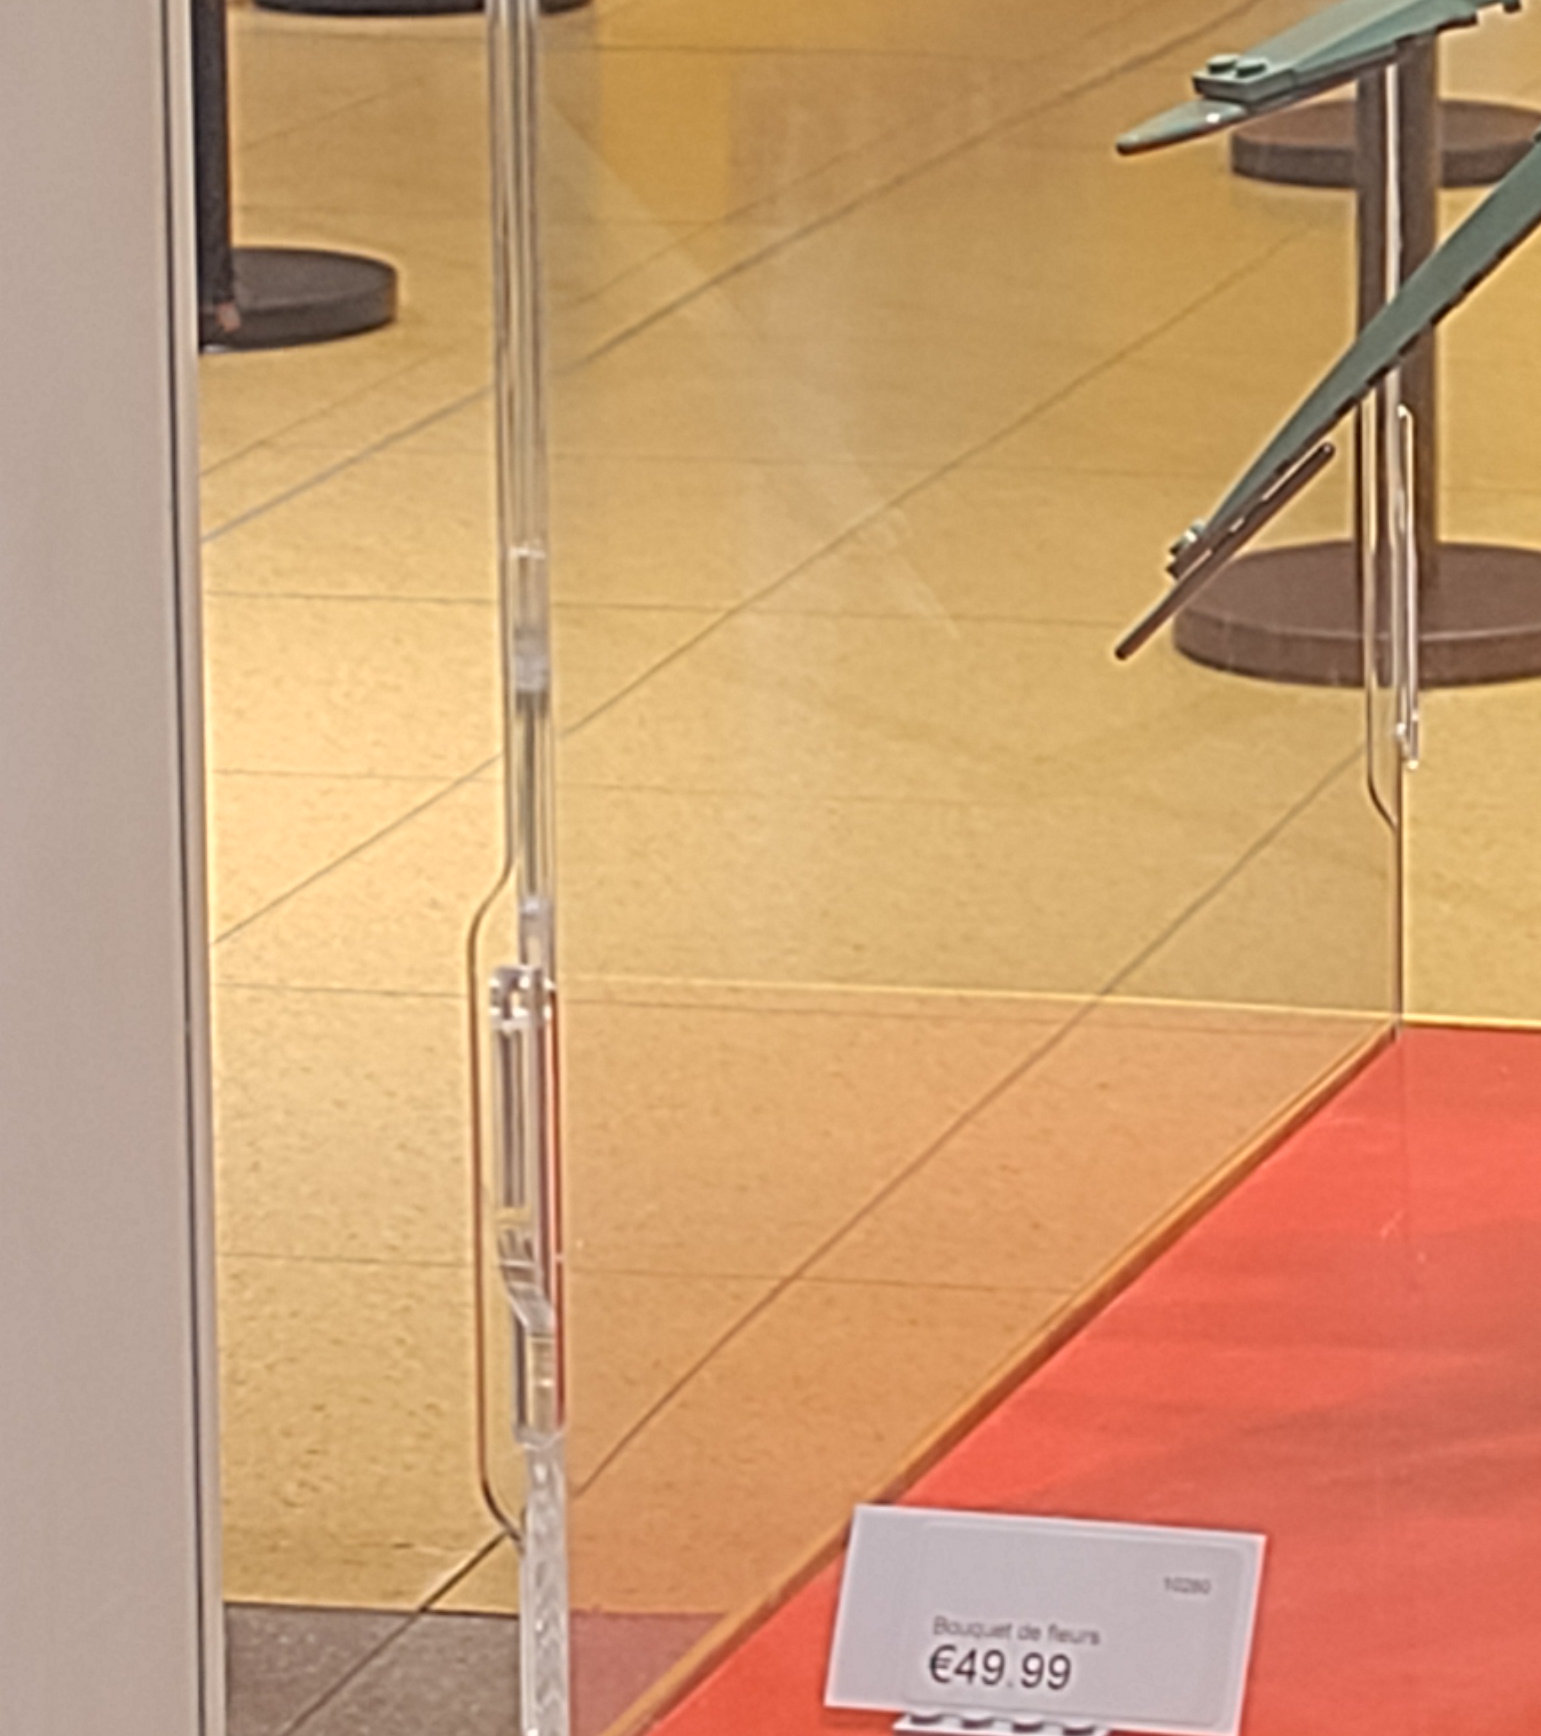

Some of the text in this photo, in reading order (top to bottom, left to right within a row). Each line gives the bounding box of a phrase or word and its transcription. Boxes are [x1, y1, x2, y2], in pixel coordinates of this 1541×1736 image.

[932, 1614, 1101, 1646] Bouquet de fleurs
[928, 1643, 1072, 1691] €49.99
